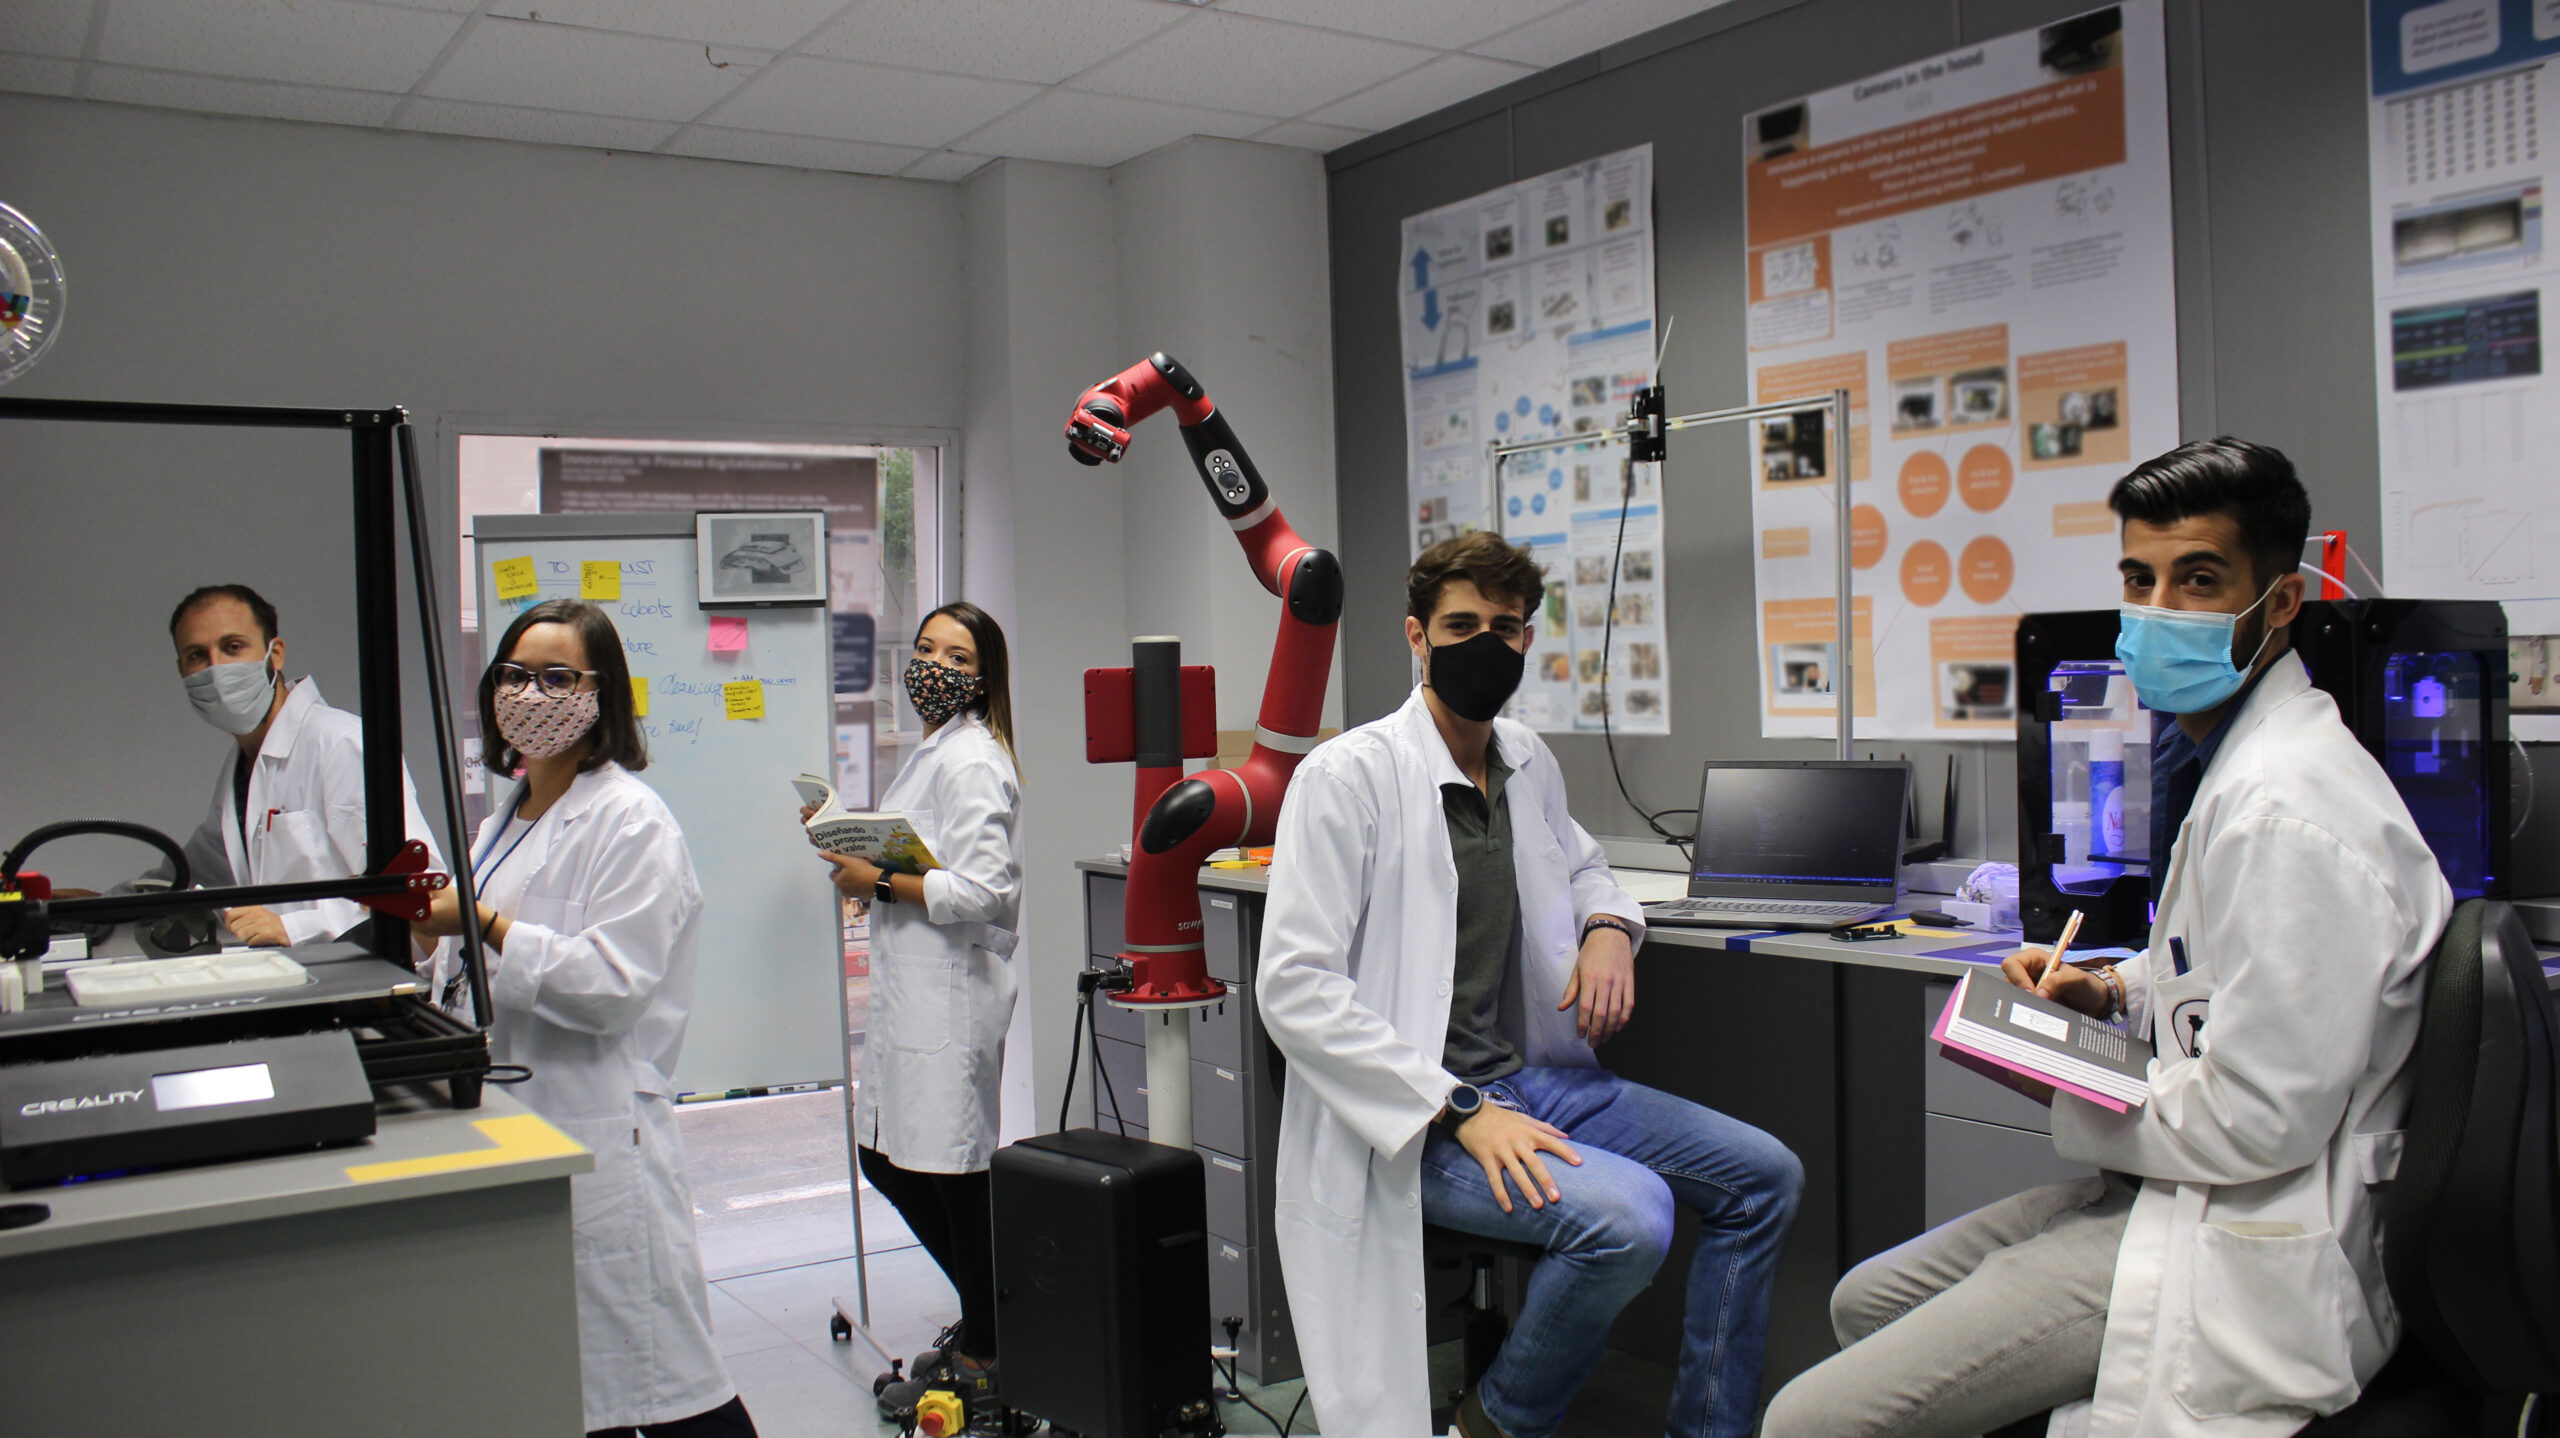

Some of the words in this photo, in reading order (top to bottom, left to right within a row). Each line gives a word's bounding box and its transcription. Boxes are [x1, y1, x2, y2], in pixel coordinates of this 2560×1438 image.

[1853, 77, 1903, 102] Camera
[1904, 69, 1919, 86] in
[1921, 64, 1944, 81] the
[1946, 49, 1985, 73] hood
[562, 452, 635, 467] Innovation
[638, 456, 651, 467] in
[654, 456, 704, 469] Process
[548, 560, 570, 575] TO
[815, 825, 866, 842] Diseñando
[820, 841, 832, 850] la
[833, 836, 880, 850] propuesta
[842, 843, 867, 853] valor
[20, 1087, 145, 1117] CREALITY
